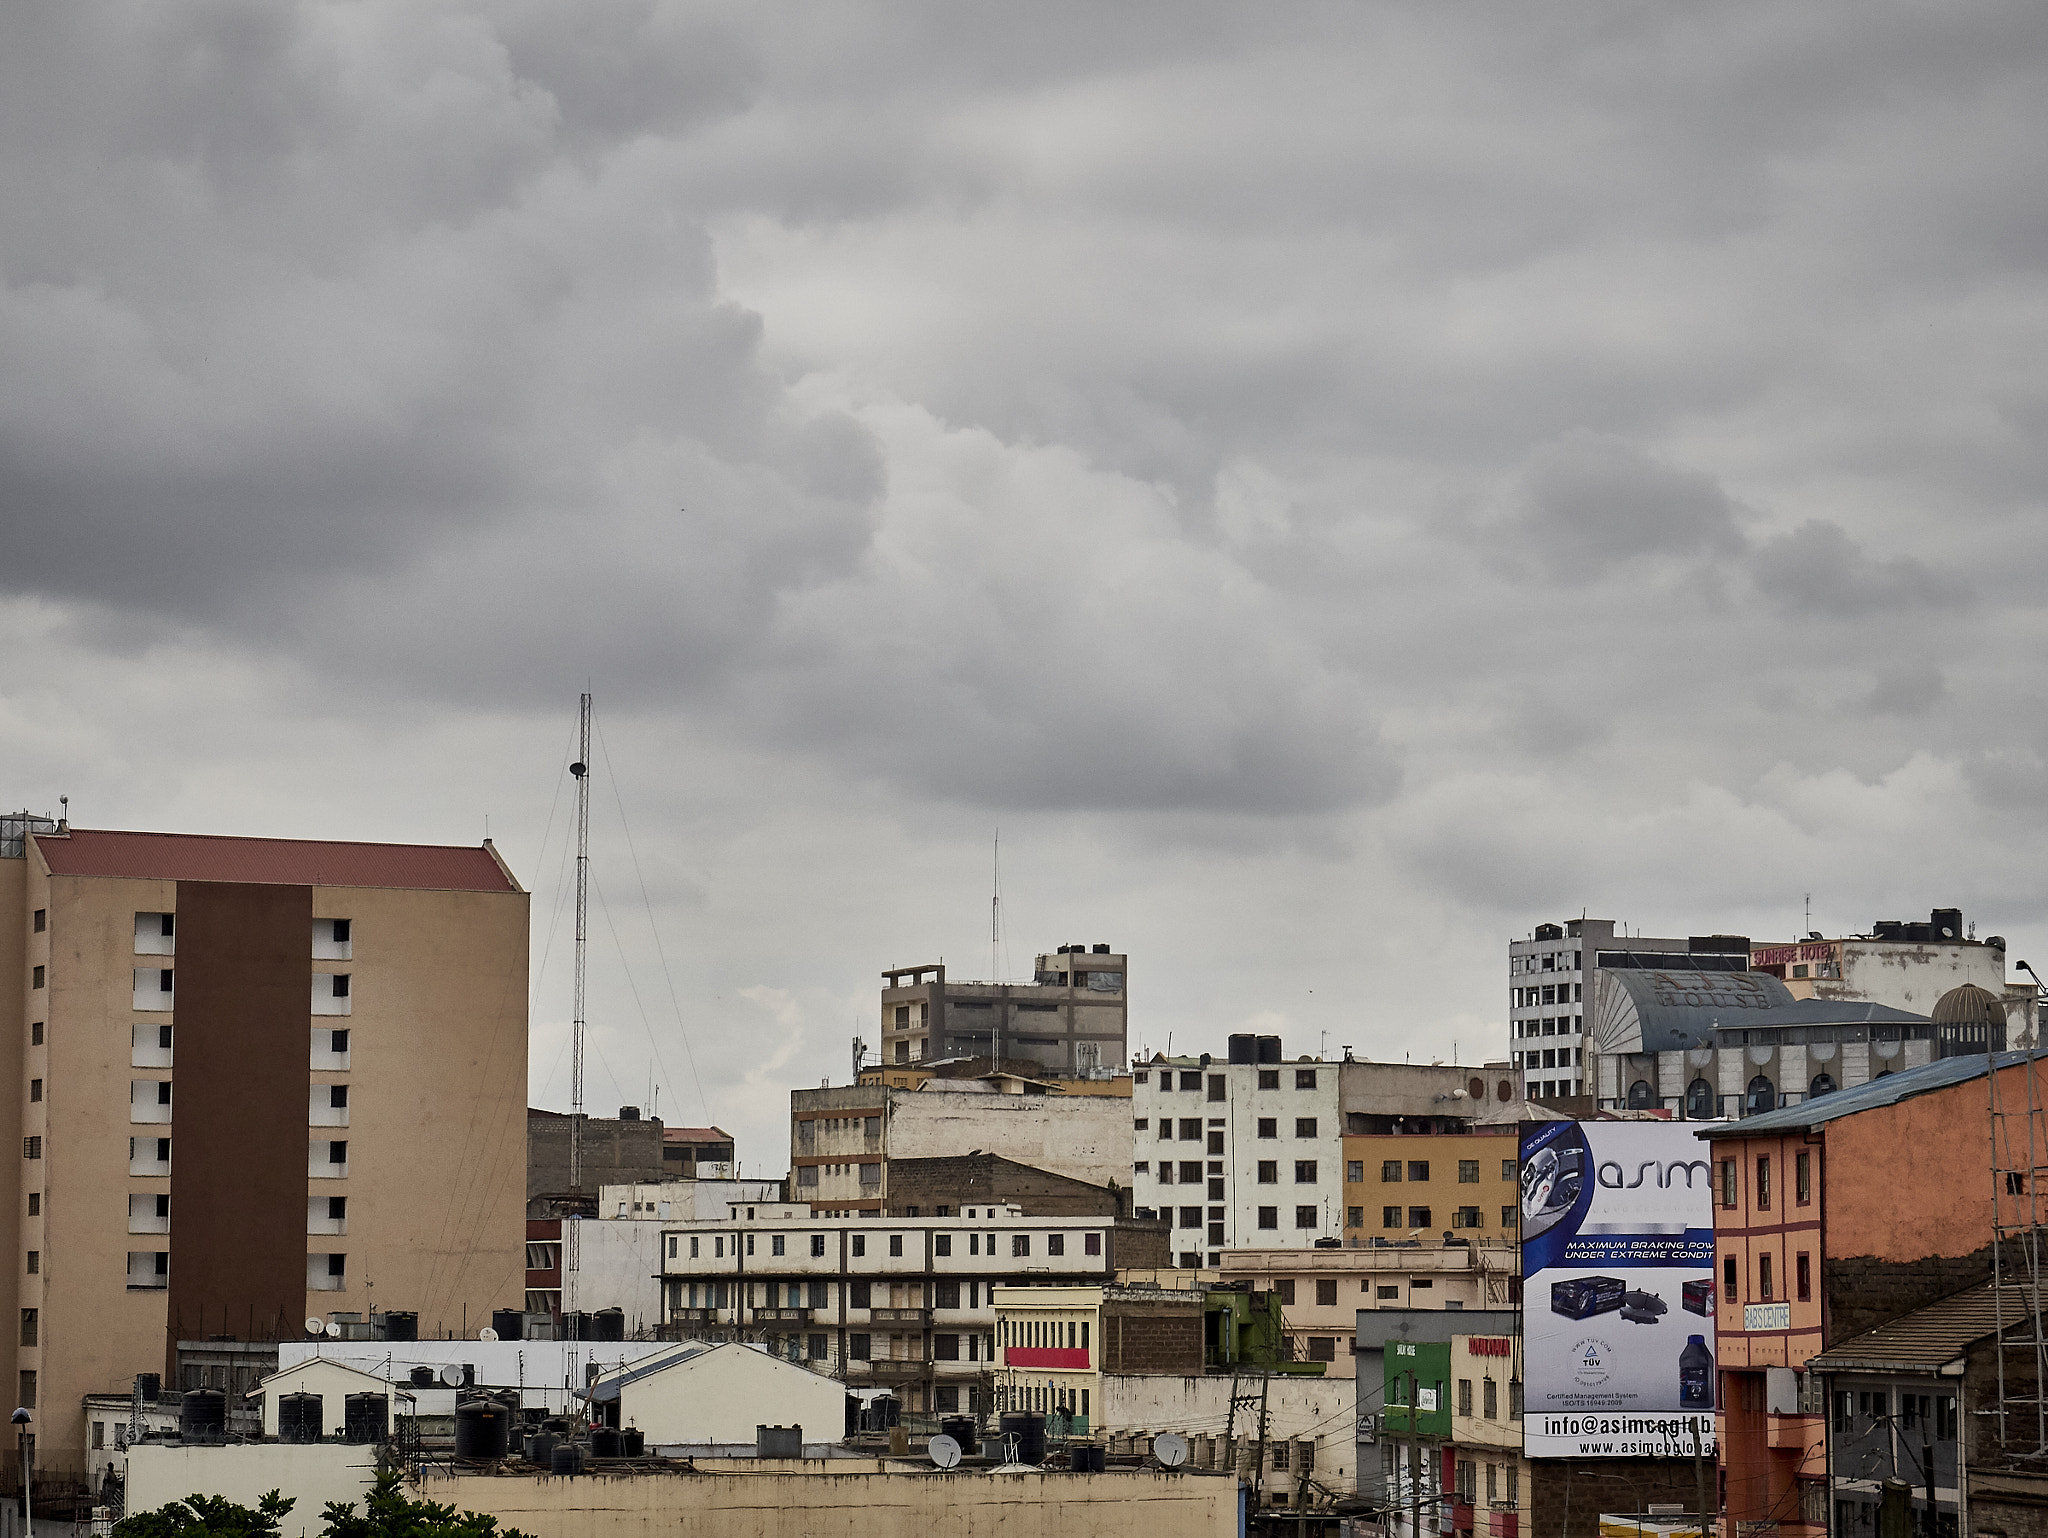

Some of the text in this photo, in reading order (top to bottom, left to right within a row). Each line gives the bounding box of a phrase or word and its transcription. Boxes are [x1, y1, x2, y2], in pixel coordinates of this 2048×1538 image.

[1754, 943, 1834, 966] SUNRISE HOTEL
[1655, 991, 1772, 1009] HOUSE
[1534, 1126, 1556, 1144] QUALITY
[1564, 1250, 1714, 1259] UNDER EXTREME CONDIT
[1566, 1241, 1714, 1250] MAXIMUM BRAKING POW
[1763, 1305, 1789, 1328] CENTRE
[1583, 1358, 1601, 1367] TÜV
[1546, 1392, 1638, 1400] Certified Management System
[1544, 1416, 1716, 1437] info@asimcoglb
